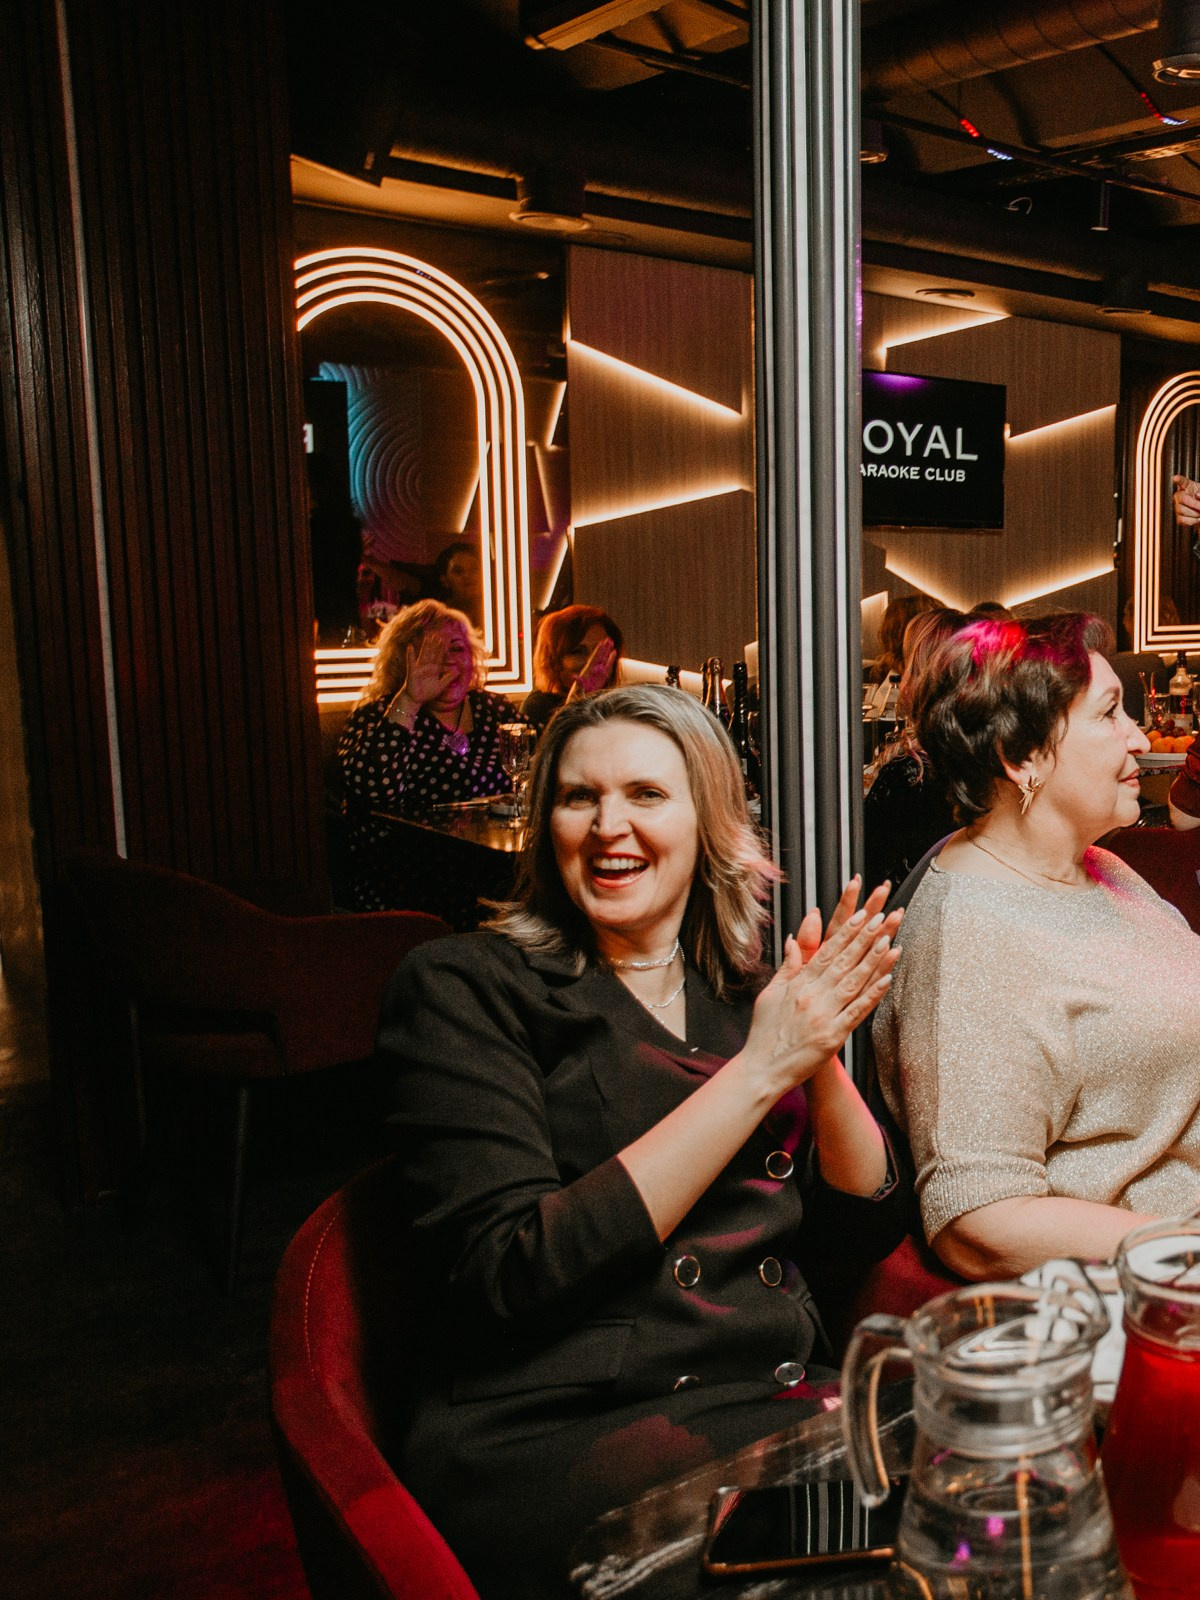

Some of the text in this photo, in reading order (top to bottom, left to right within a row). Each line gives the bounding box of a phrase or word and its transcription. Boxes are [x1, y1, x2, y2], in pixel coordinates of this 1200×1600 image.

[862, 419, 978, 460] OYAL
[860, 463, 966, 482] ARAOKE CLUB
